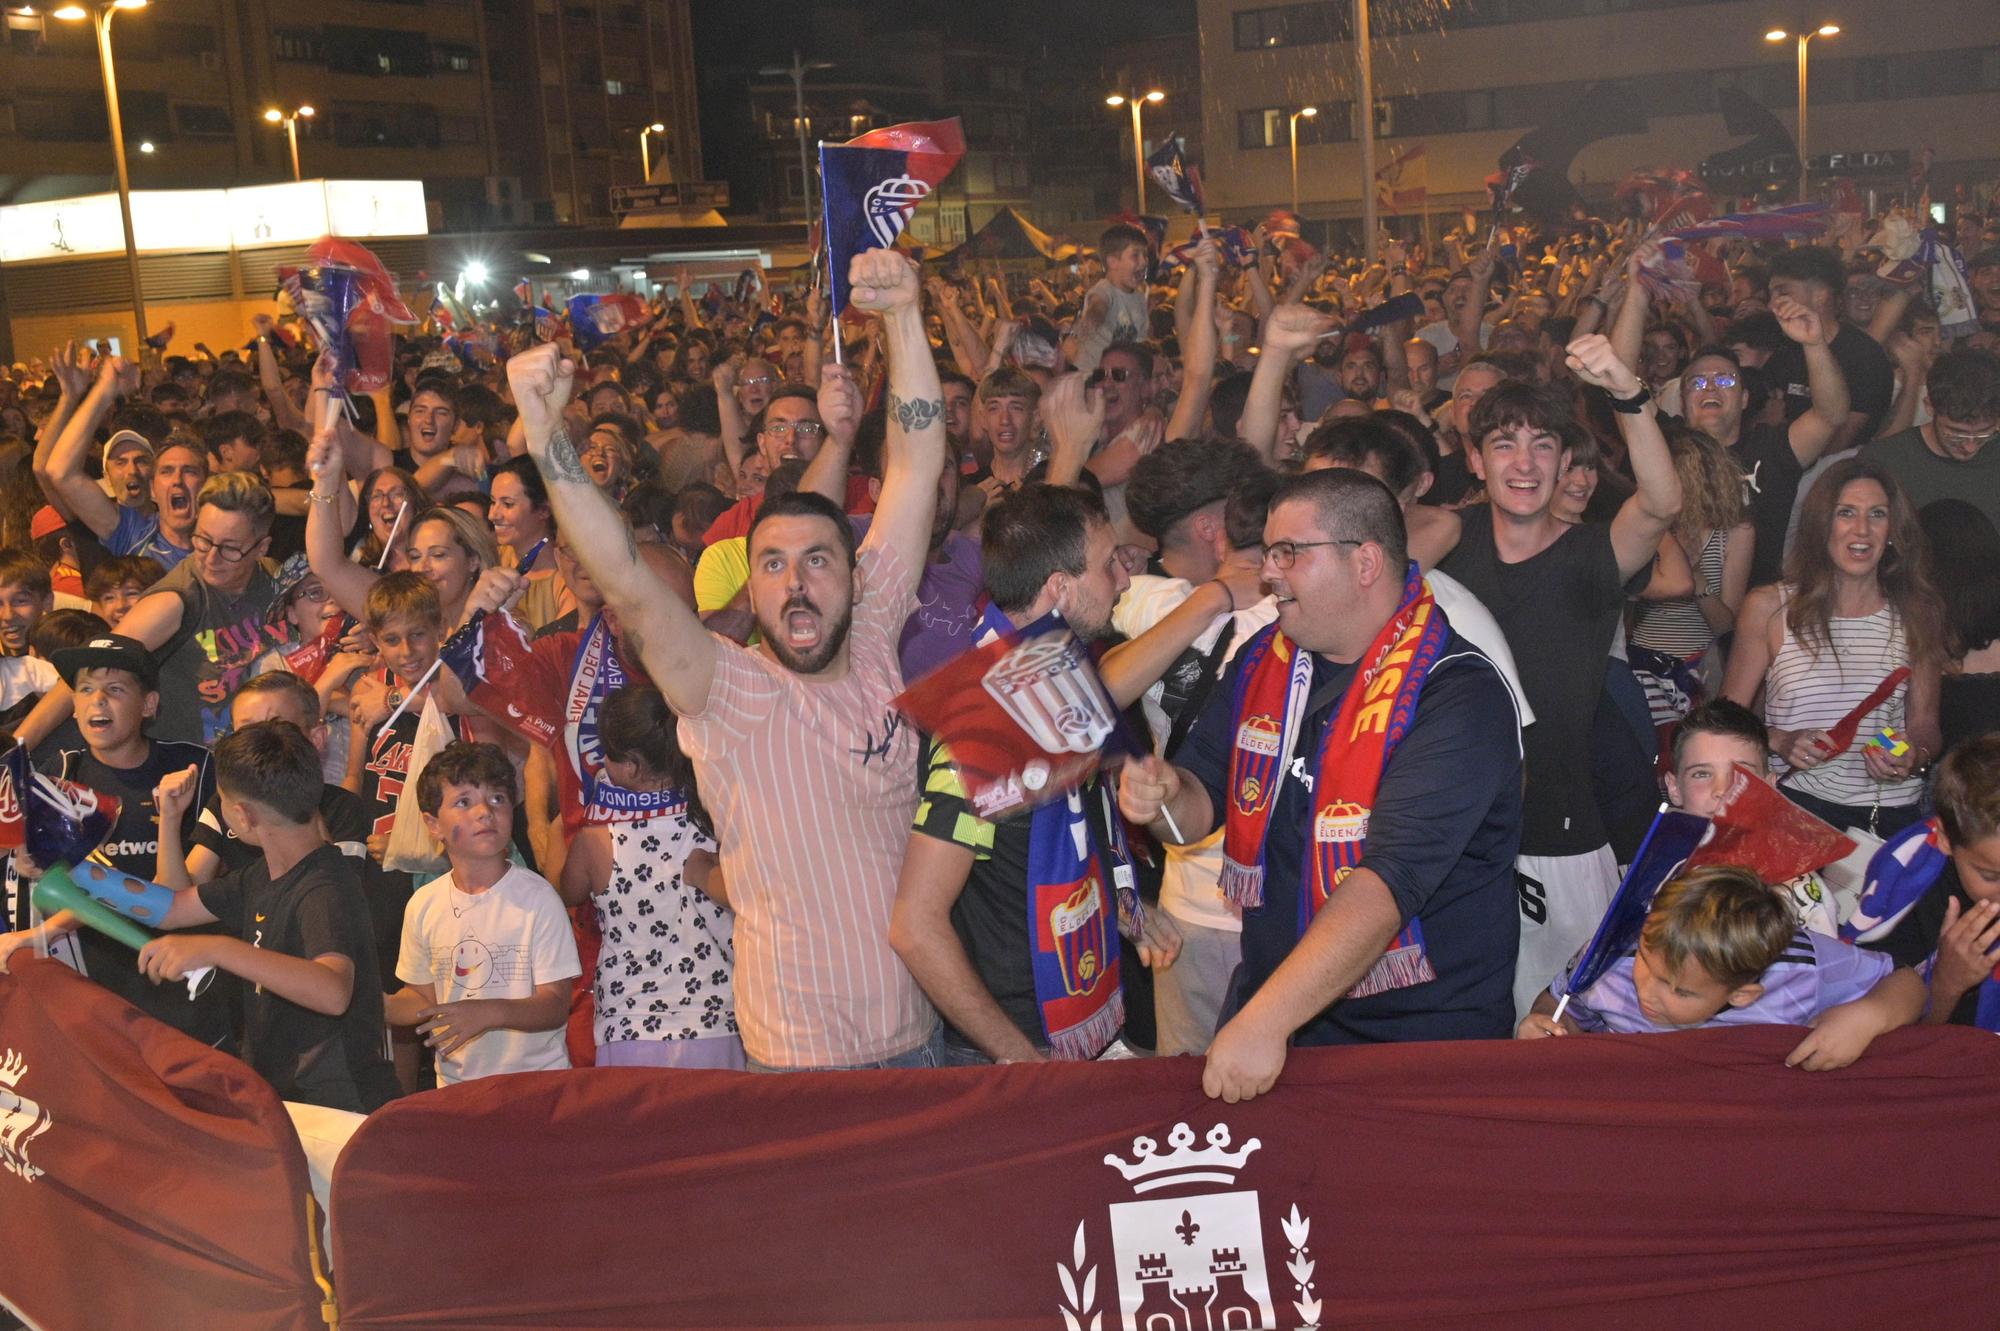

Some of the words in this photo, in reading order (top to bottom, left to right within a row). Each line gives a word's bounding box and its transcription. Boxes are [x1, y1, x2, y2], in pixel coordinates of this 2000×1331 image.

[1828, 152, 1896, 169] ELDA
[525, 715, 533, 723] A
[535, 718, 556, 735] Punt
[365, 729, 414, 775] LAK
[599, 789, 671, 807] SEGUNDA
[104, 839, 158, 856] etwo
